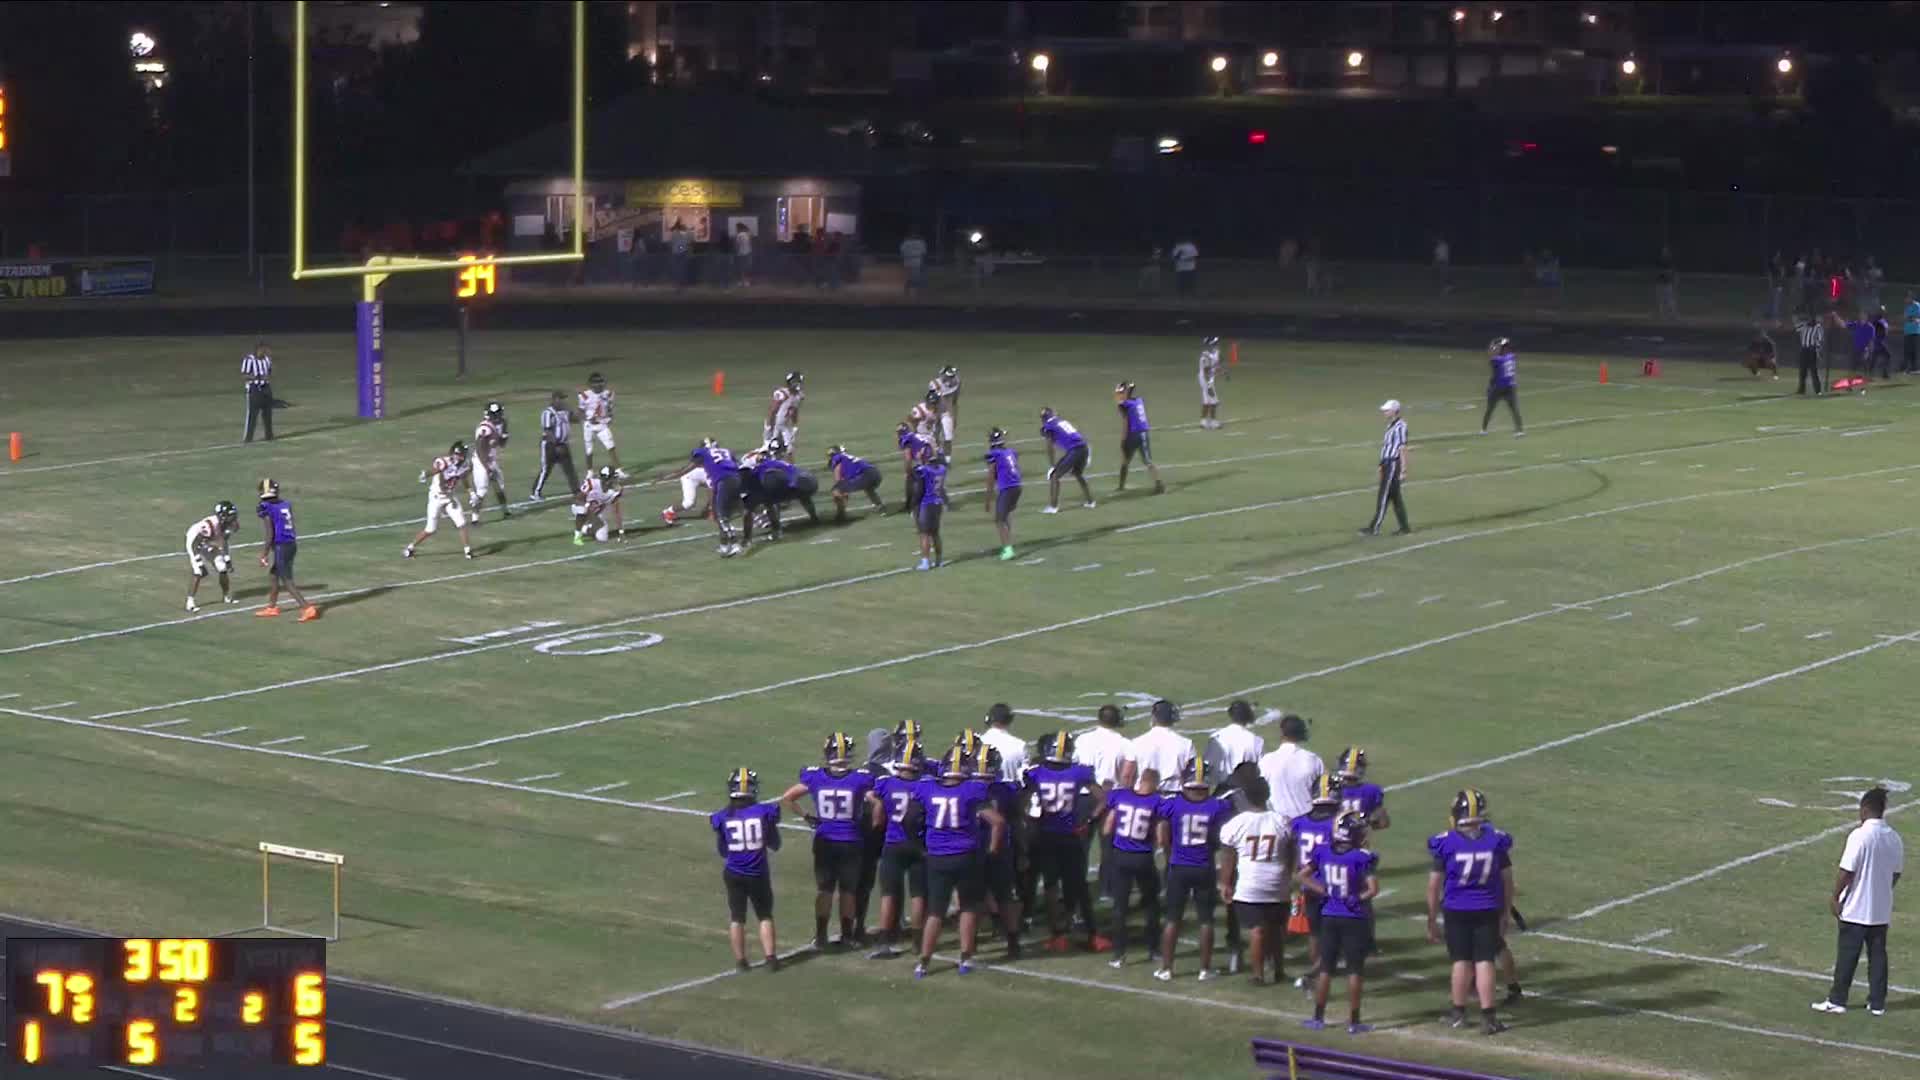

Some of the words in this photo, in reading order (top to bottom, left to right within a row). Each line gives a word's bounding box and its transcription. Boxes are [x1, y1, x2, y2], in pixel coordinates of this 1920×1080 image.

[457, 254, 495, 297] 34
[817, 789, 854, 819] 63
[890, 791, 914, 823] 3
[931, 796, 960, 829] 71
[725, 817, 763, 852] 30
[1117, 804, 1152, 841] 36
[1182, 813, 1209, 845] 15
[1246, 834, 1277, 862] 77
[1300, 832, 1324, 865] 2
[1324, 864, 1349, 898] 14
[1455, 850, 1493, 887] 77
